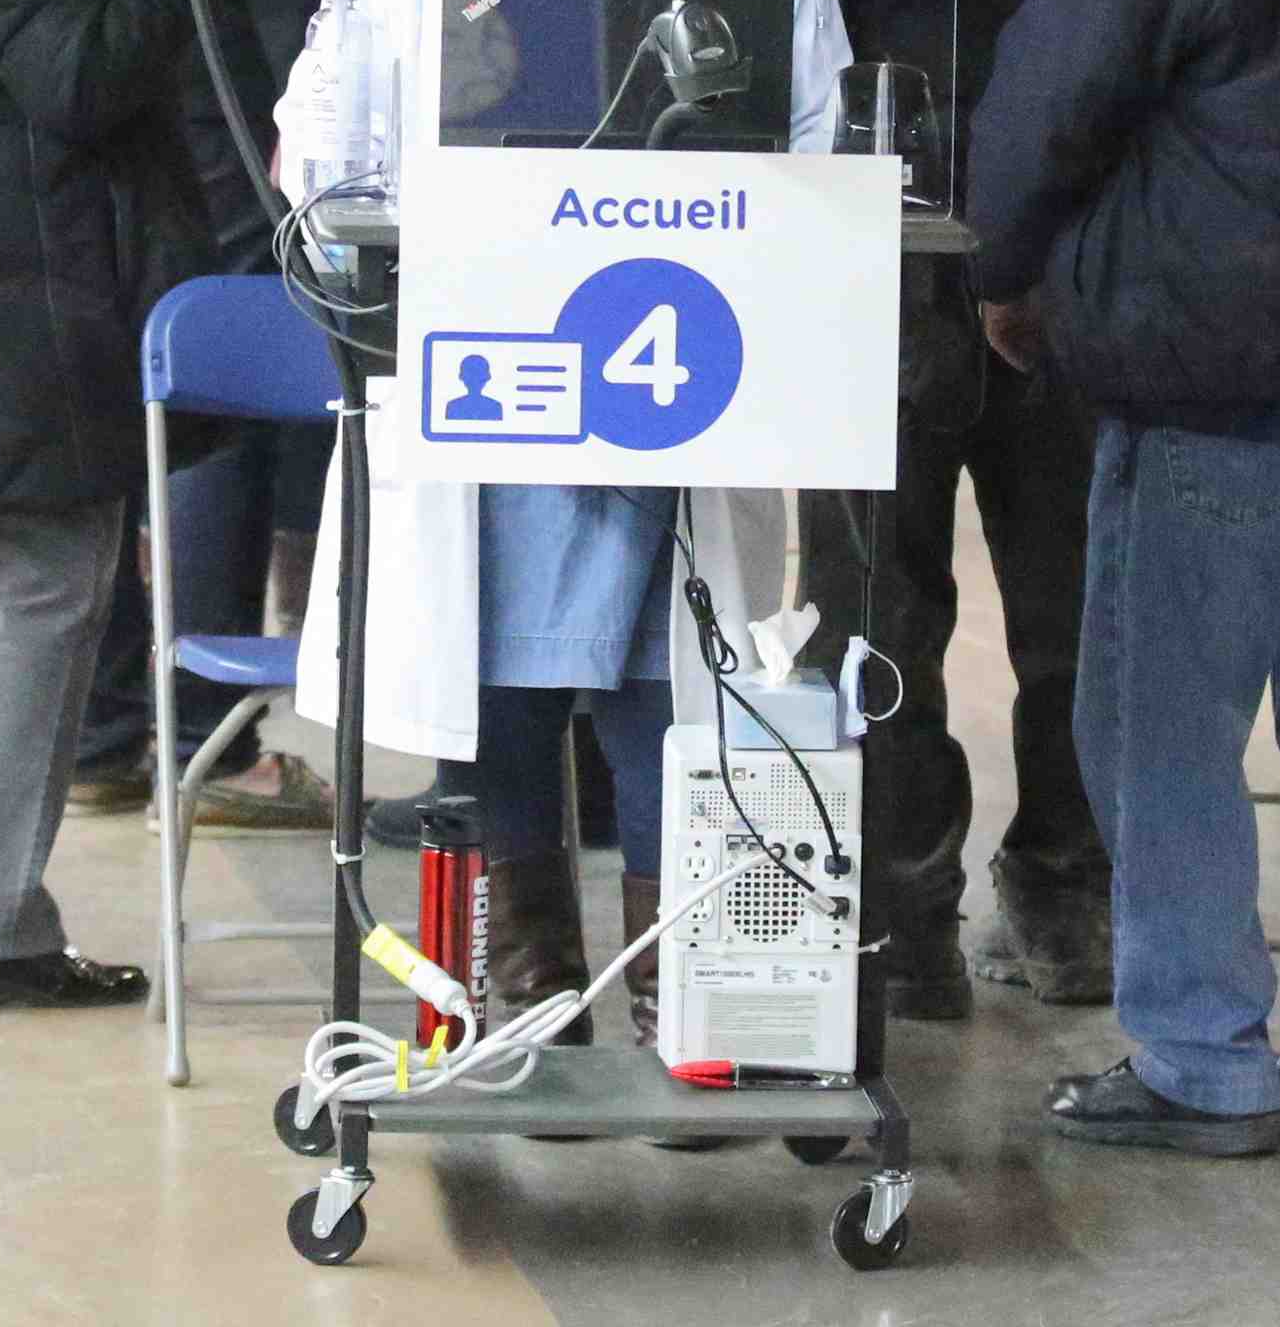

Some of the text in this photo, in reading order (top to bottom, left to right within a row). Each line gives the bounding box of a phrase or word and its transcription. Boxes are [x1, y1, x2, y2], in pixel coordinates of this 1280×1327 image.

[551, 188, 746, 230] Accueil
[602, 303, 691, 407] 4
[471, 875, 489, 998] CANADA
